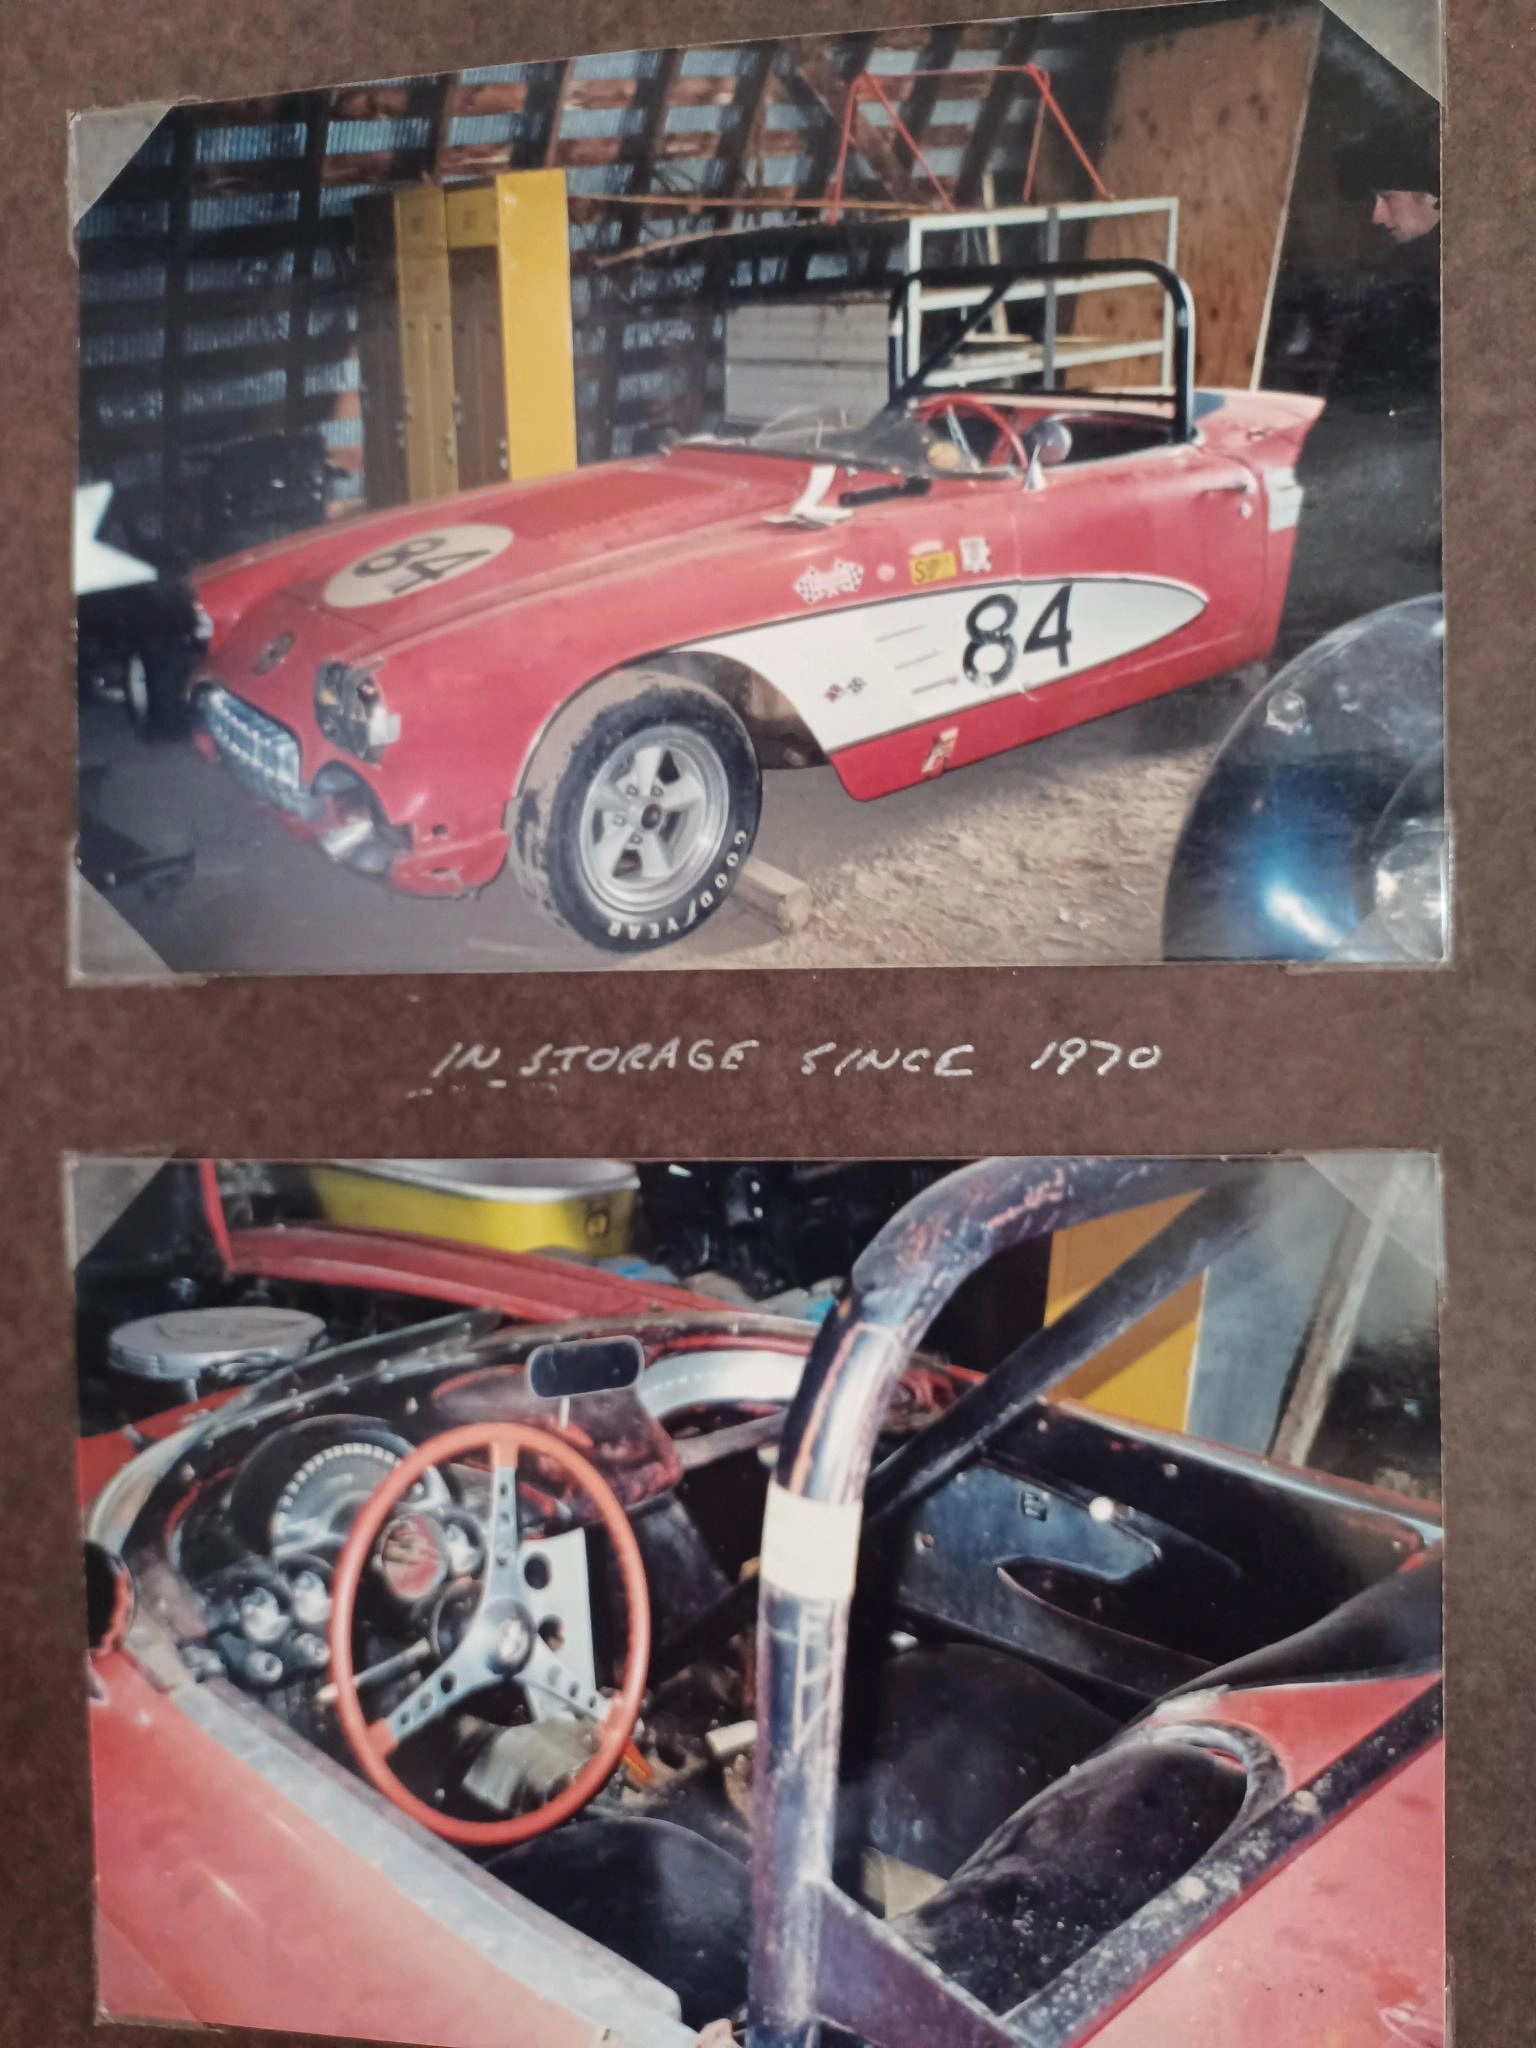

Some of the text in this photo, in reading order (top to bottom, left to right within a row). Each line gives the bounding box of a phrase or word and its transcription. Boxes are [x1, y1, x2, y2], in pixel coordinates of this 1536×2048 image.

[353, 536, 491, 594] 84
[963, 581, 1072, 687] 84
[431, 1036, 1162, 1078] IN STORAGE SINCE 1970
